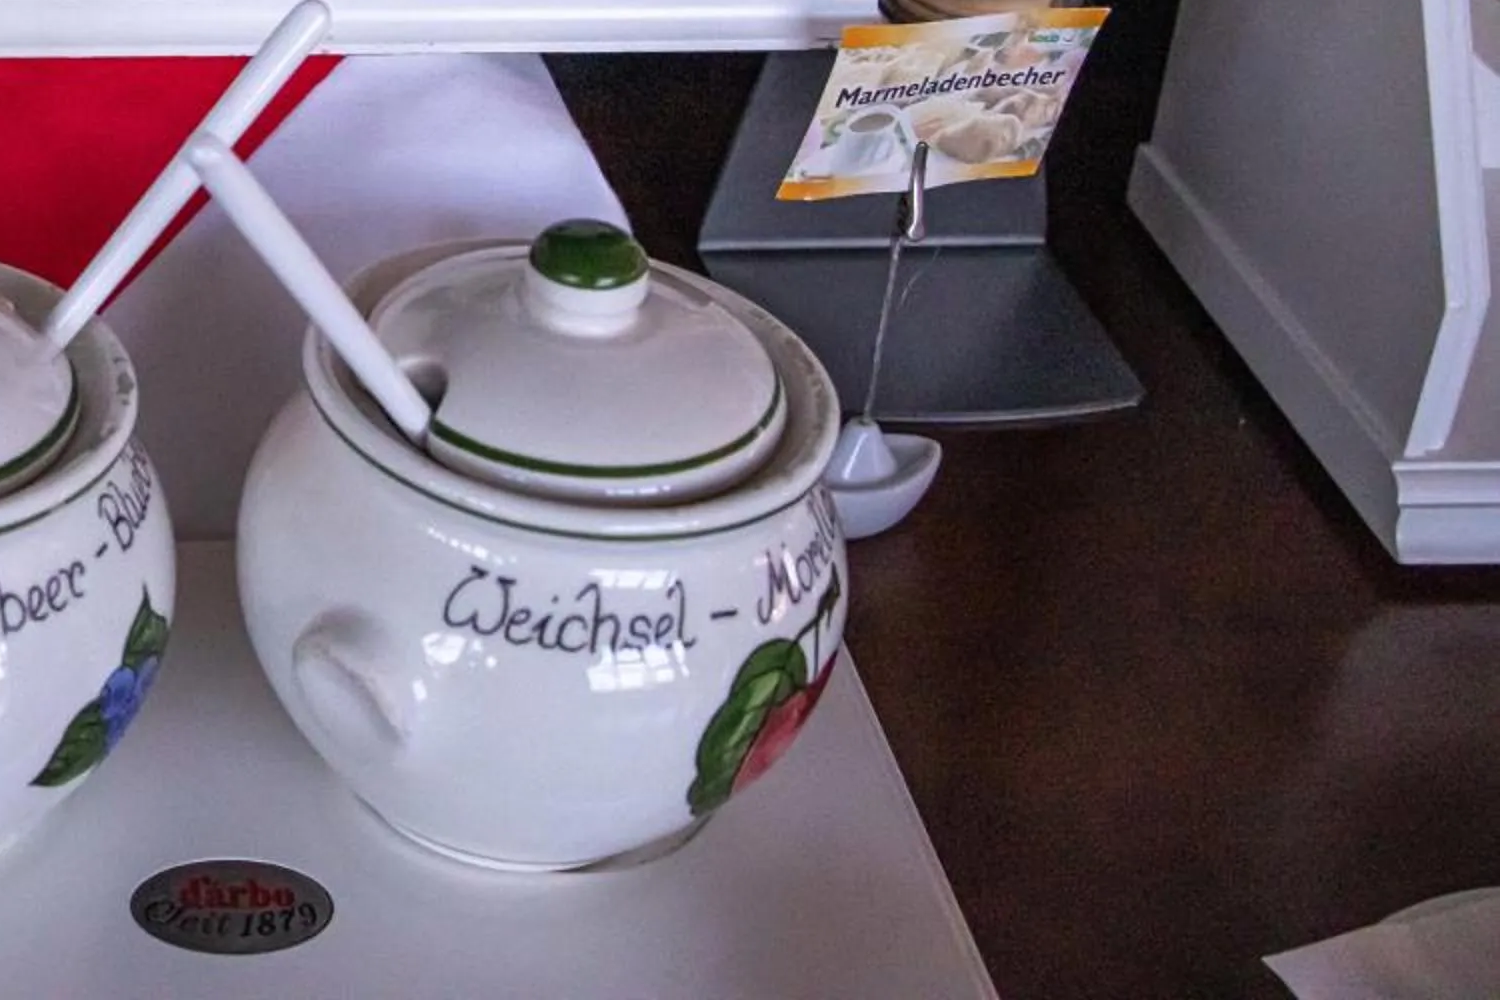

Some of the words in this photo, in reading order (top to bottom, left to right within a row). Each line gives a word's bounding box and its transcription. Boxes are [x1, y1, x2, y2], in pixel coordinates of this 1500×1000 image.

[835, 66, 1066, 108] Marmeladenbecher
[442, 564, 698, 654] Weichsel
[239, 902, 319, 938] 1879
